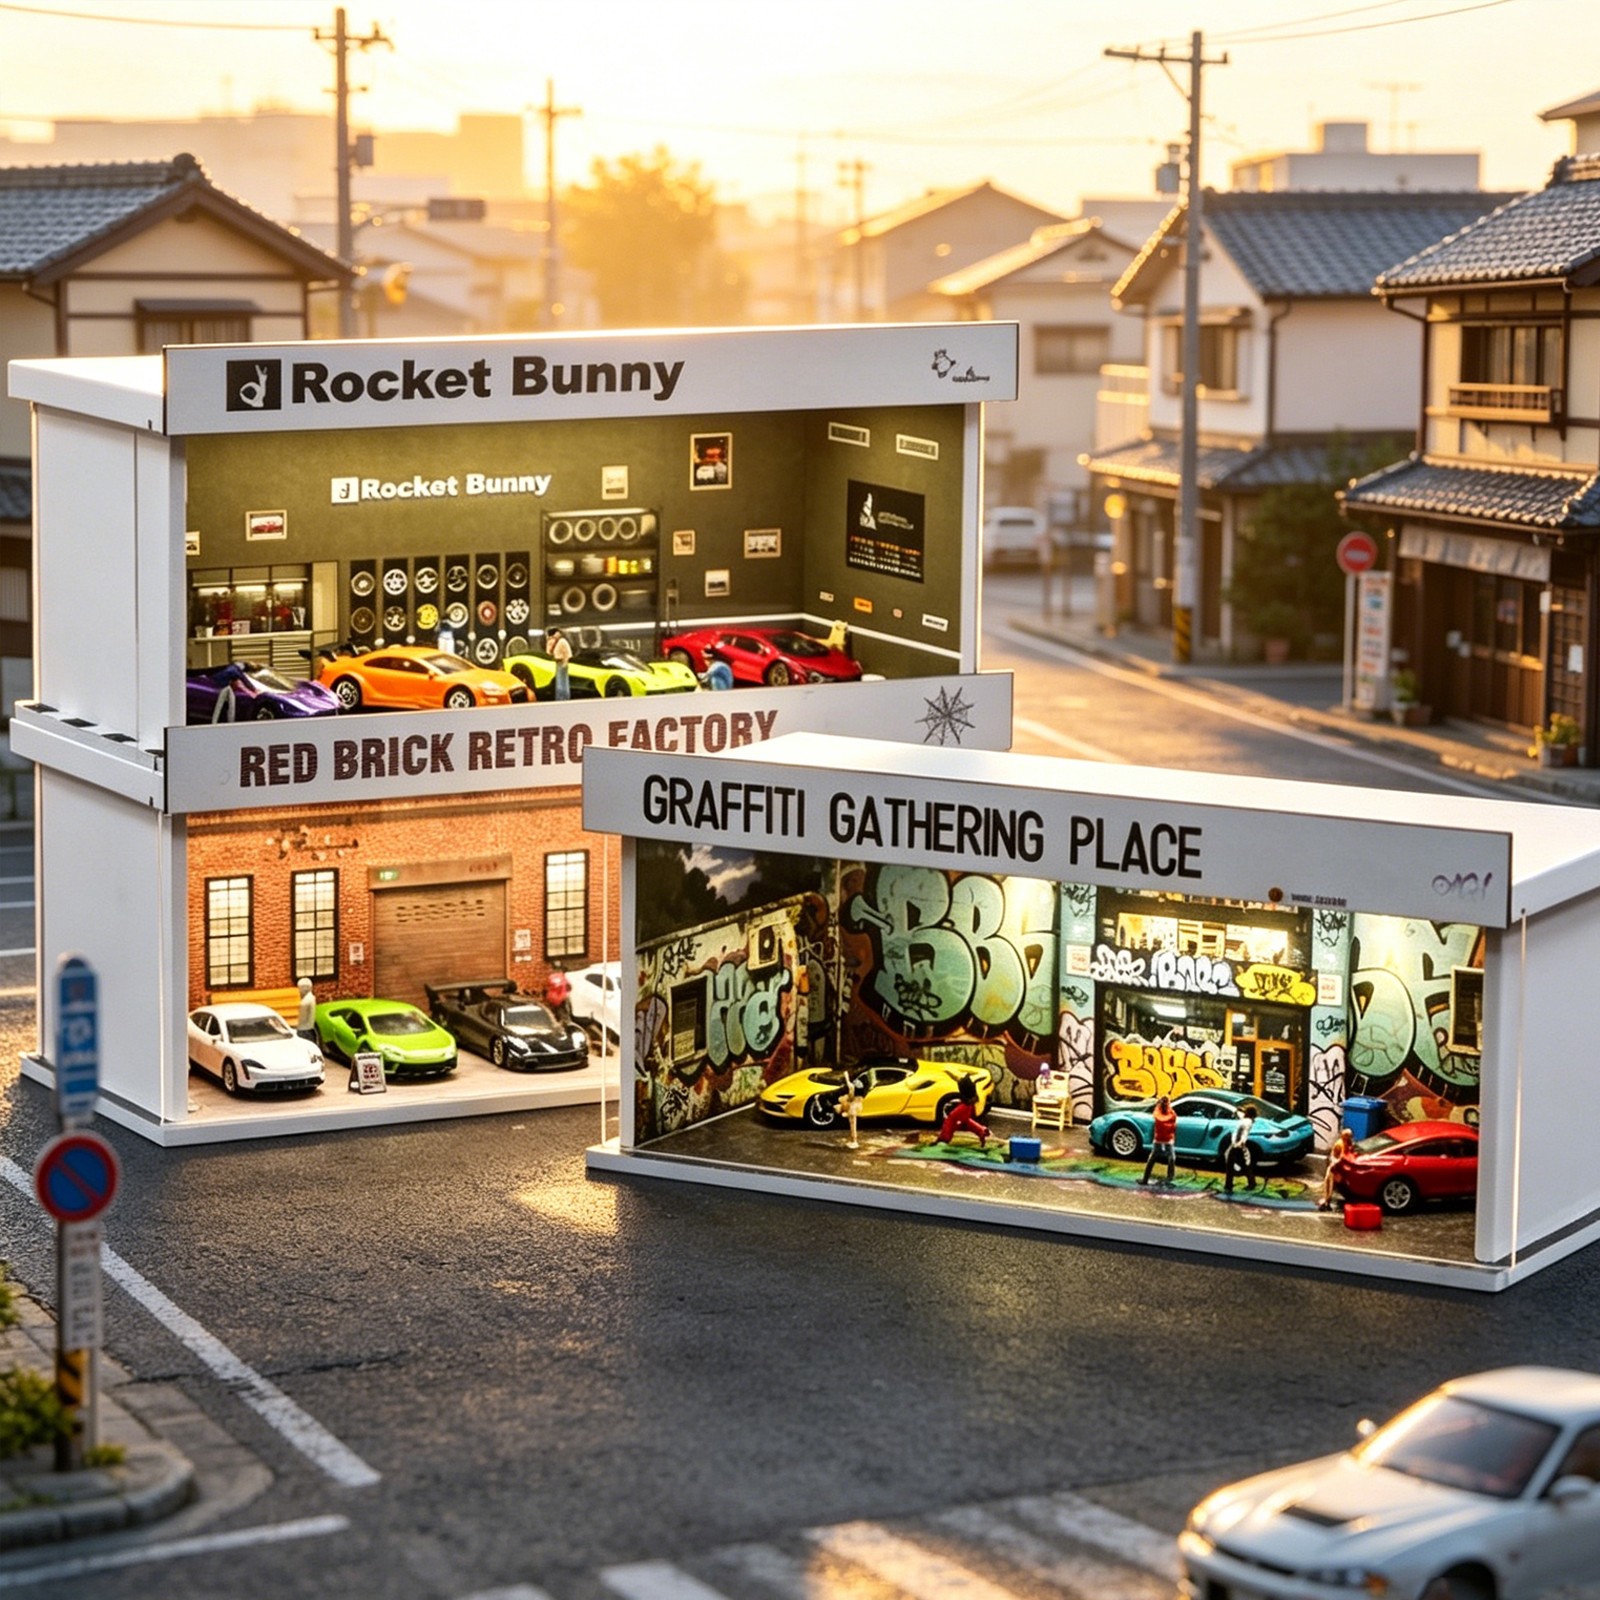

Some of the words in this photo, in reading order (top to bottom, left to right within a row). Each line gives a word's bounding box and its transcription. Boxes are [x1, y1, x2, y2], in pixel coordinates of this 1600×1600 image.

[291, 358, 492, 404] Rocket
[512, 355, 685, 401] Bunny
[360, 475, 459, 499] Rocket
[465, 473, 552, 496] Bunny
[239, 742, 318, 788] RED
[333, 734, 455, 781] BRICK
[468, 722, 593, 771] RETRO
[608, 709, 779, 754] FACTORY
[643, 774, 805, 838] GRAFFITI
[829, 792, 1044, 863] GATHERING
[1069, 815, 1203, 880] PLACE
